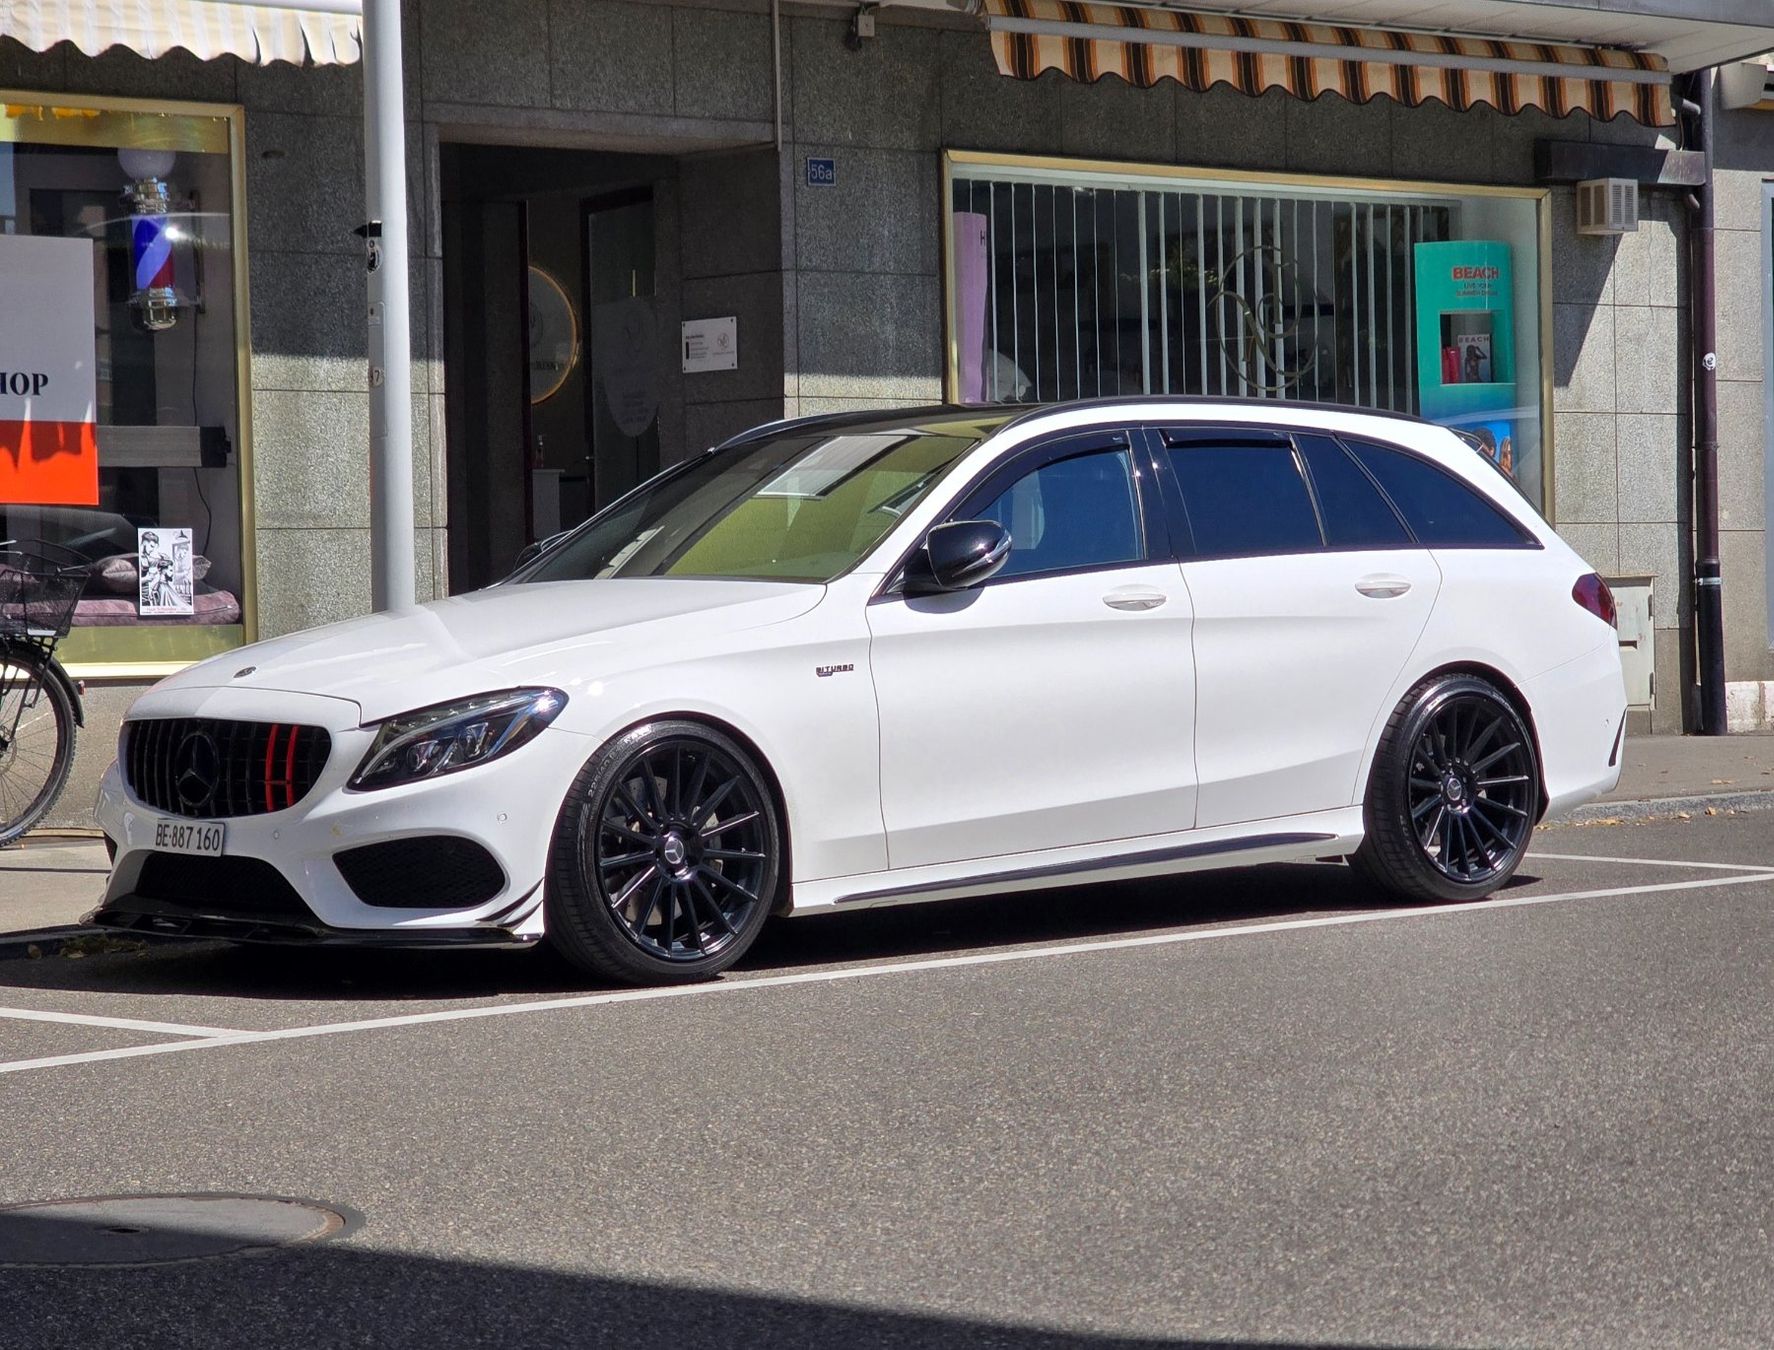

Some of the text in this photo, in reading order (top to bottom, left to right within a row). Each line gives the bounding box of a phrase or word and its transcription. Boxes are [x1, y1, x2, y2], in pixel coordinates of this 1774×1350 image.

[811, 163, 832, 180] 56a
[1453, 266, 1499, 280] BEACH
[1458, 336, 1490, 344] BEACH
[816, 664, 854, 673] BITURBO
[196, 827, 220, 852] 160
